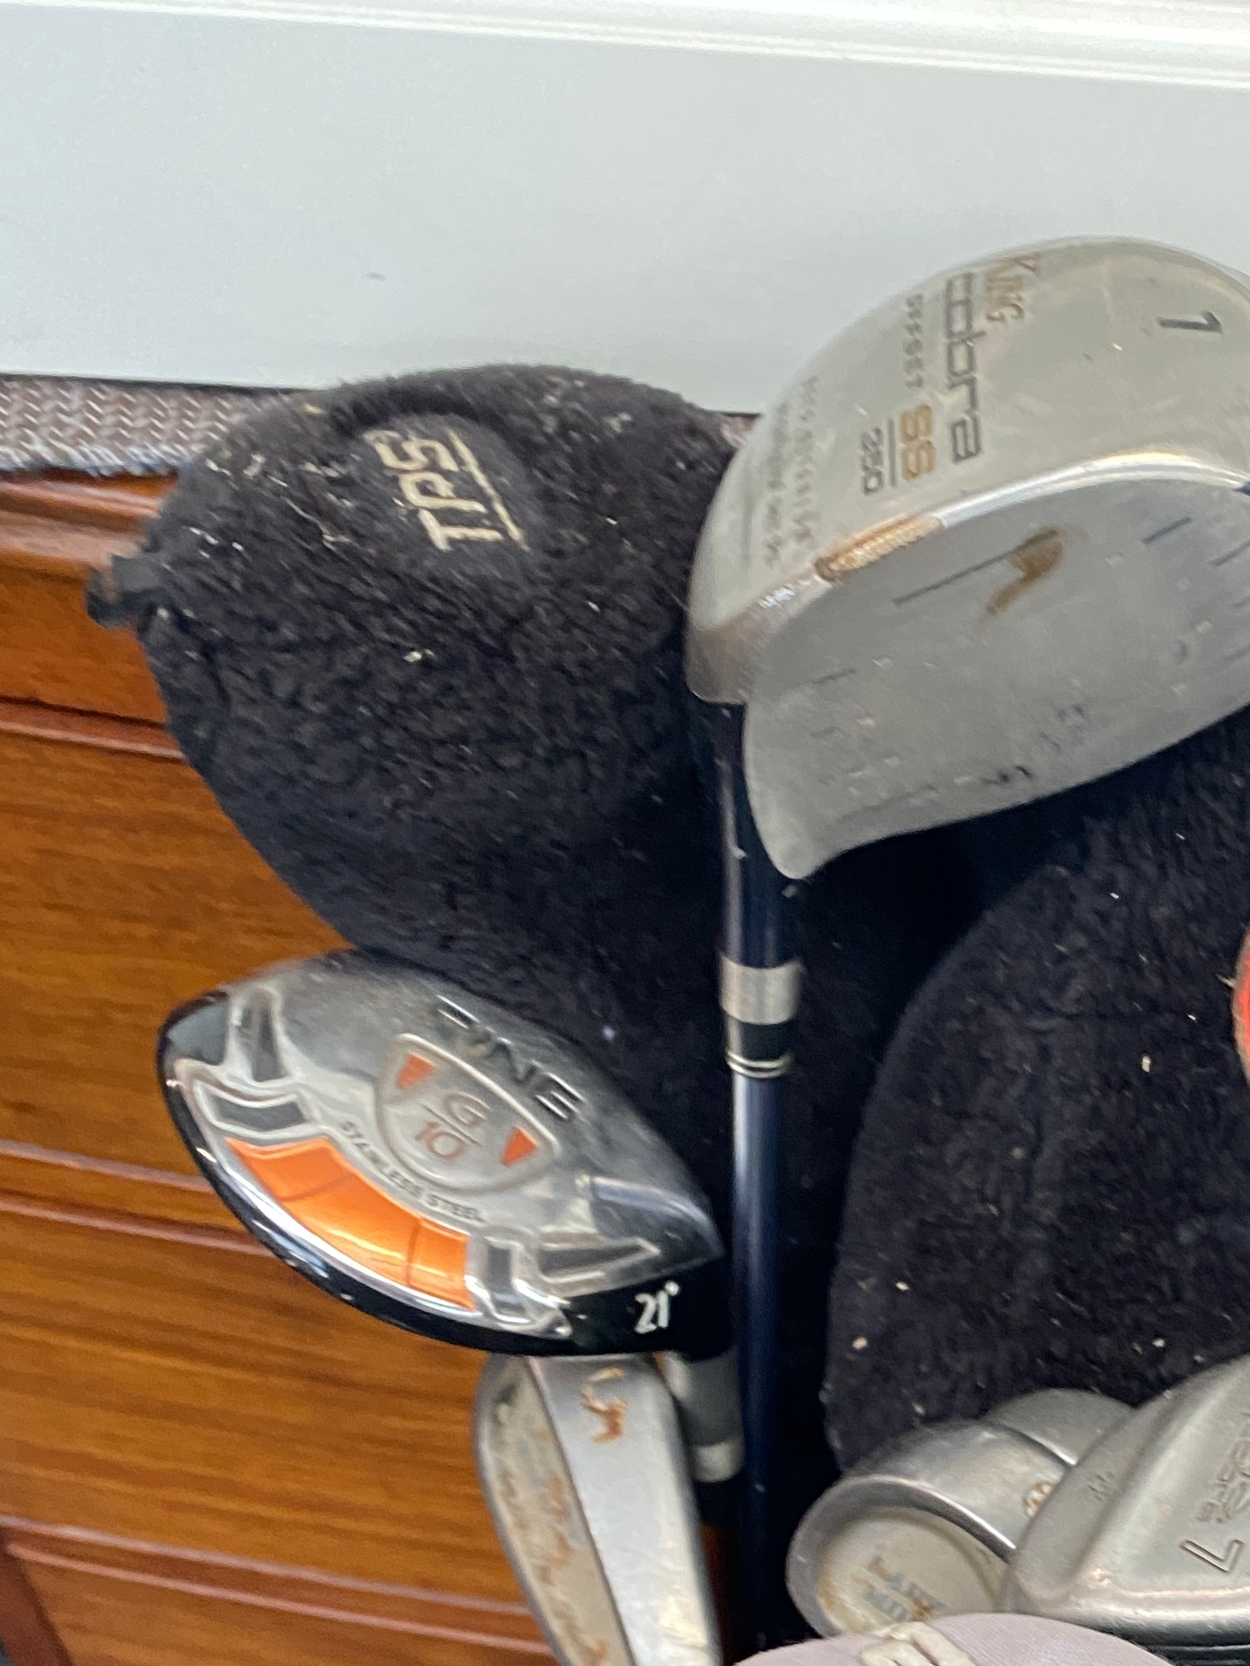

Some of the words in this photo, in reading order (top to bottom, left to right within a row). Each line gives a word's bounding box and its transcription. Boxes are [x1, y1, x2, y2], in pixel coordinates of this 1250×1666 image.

[985, 251, 1042, 322] KING
[1156, 309, 1223, 334] 1
[944, 271, 986, 464] cobra
[860, 425, 884, 496] 250
[900, 402, 935, 482] SS
[367, 432, 505, 552] TPS
[1179, 1538, 1245, 1574] 7
